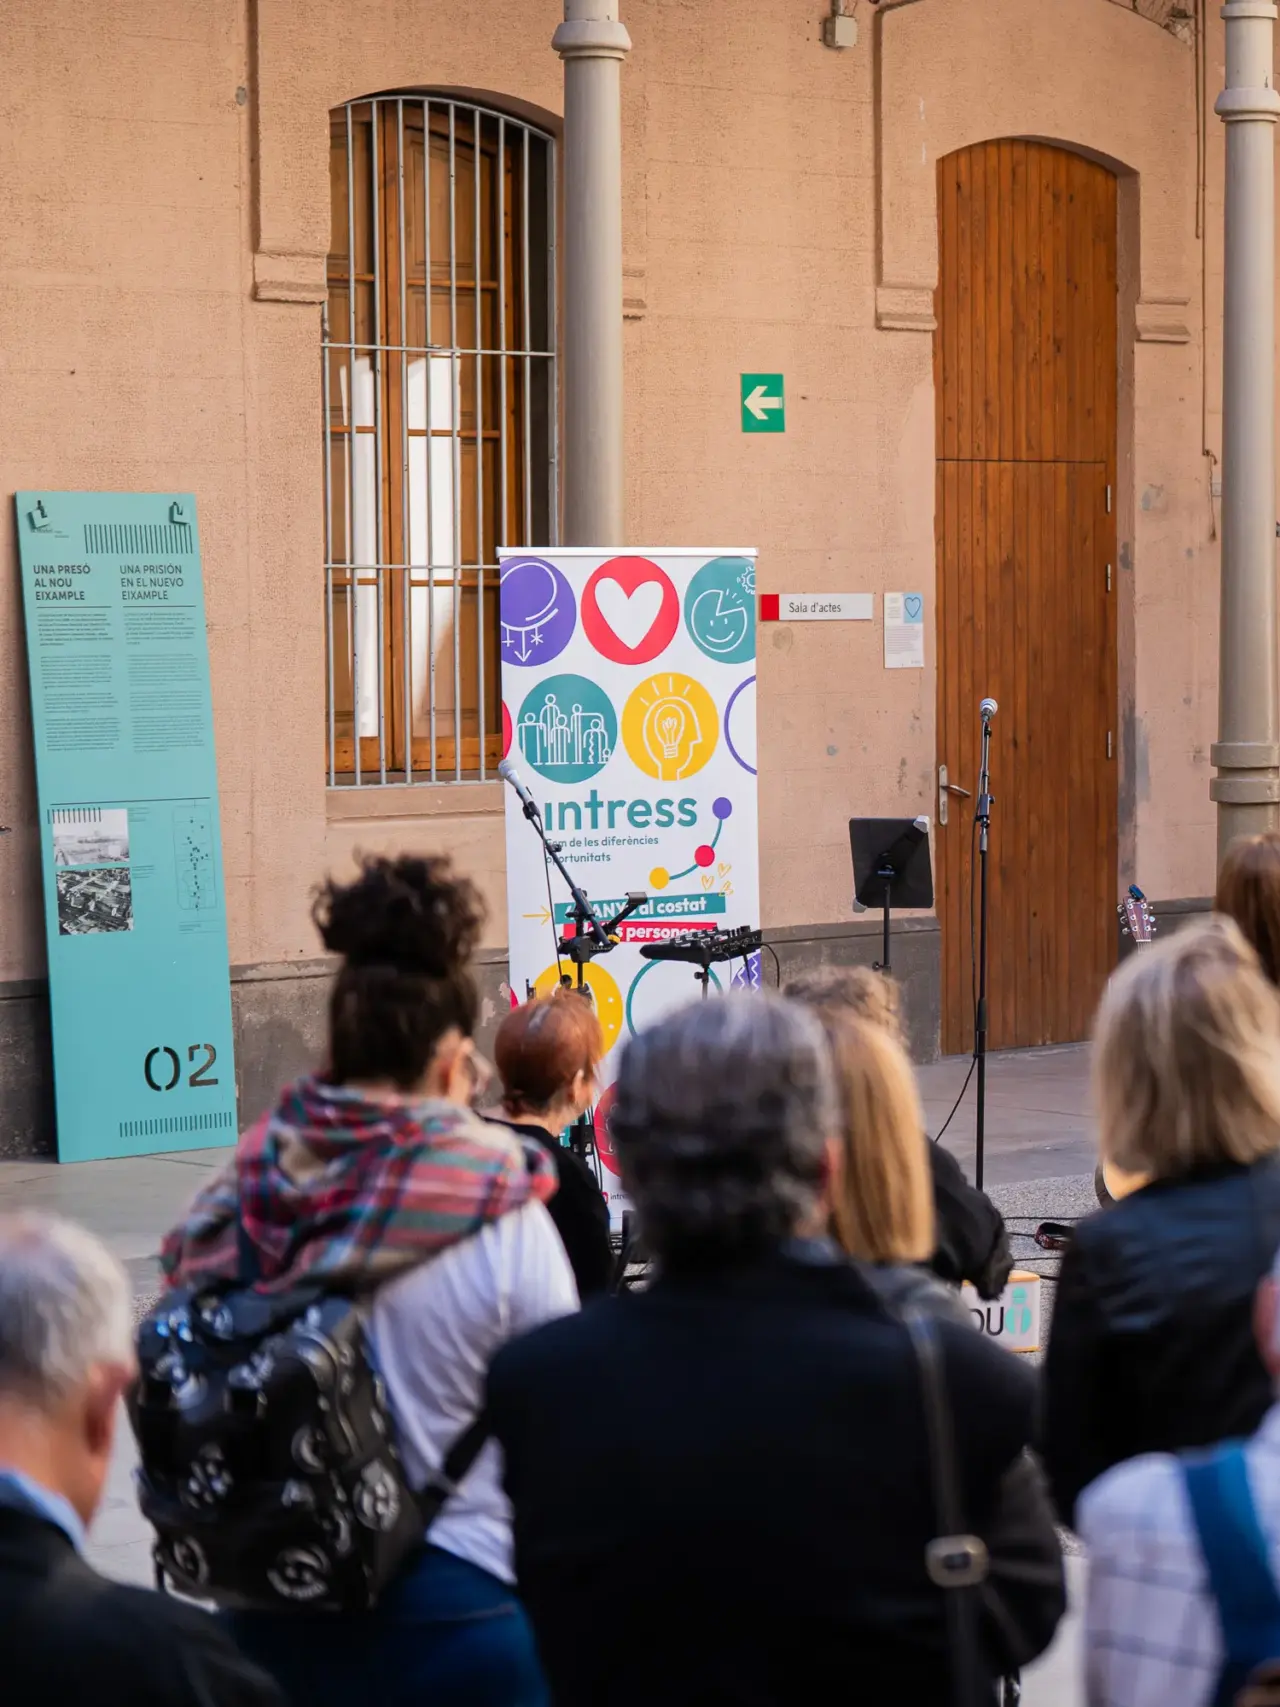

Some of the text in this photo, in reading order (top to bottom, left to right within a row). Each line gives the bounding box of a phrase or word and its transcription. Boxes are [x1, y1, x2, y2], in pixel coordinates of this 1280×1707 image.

[33, 562, 91, 574] UNA PRESÓ
[119, 562, 182, 574] UNA PRISIÓN
[34, 578, 72, 587] AL NOU
[121, 577, 184, 587] EN EL NUEVO
[35, 591, 85, 600] EIXAMPLE
[122, 590, 169, 600] EIXAMPLE
[789, 602, 842, 613] Sala d'actes
[544, 789, 698, 831] intress
[569, 837, 582, 847] de
[584, 836, 599, 847] les
[601, 835, 659, 847] diferències
[545, 852, 611, 865] oortunitats
[639, 903, 654, 915] al
[657, 897, 707, 914] costat
[144, 1043, 219, 1092] 02
